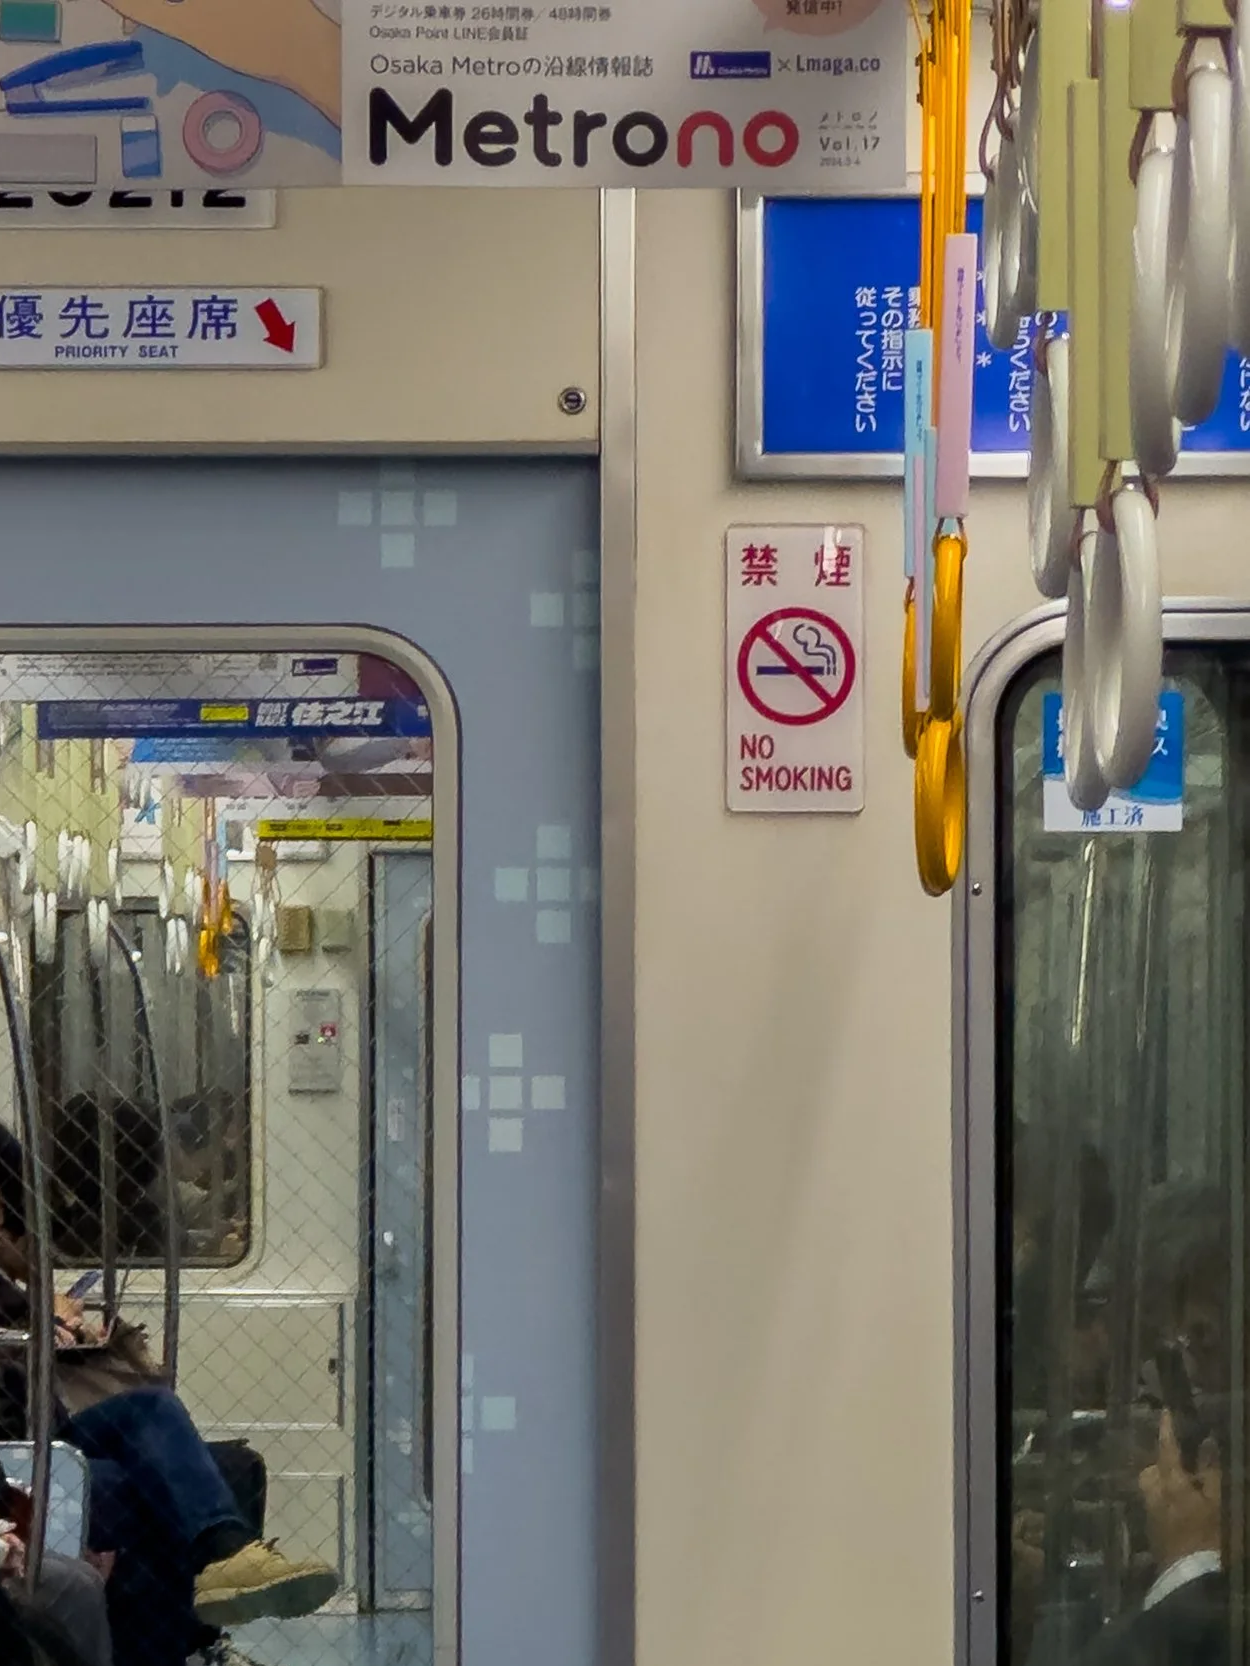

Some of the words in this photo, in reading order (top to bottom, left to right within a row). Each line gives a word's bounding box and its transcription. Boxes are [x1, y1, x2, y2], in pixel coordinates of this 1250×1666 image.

[370, 54, 443, 75] Osaka
[452, 54, 654, 77] Metroの沿線情報誌
[796, 54, 881, 76] Lmaga.co
[368, 87, 799, 168] Metrono
[54, 344, 129, 359] PRIORITY
[138, 344, 179, 359] SEAT
[881, 286, 904, 391] その指示に
[855, 286, 878, 433] 従ってください
[740, 543, 852, 588] 禁煙
[740, 734, 775, 760] NO
[739, 765, 852, 792] SMOKING
